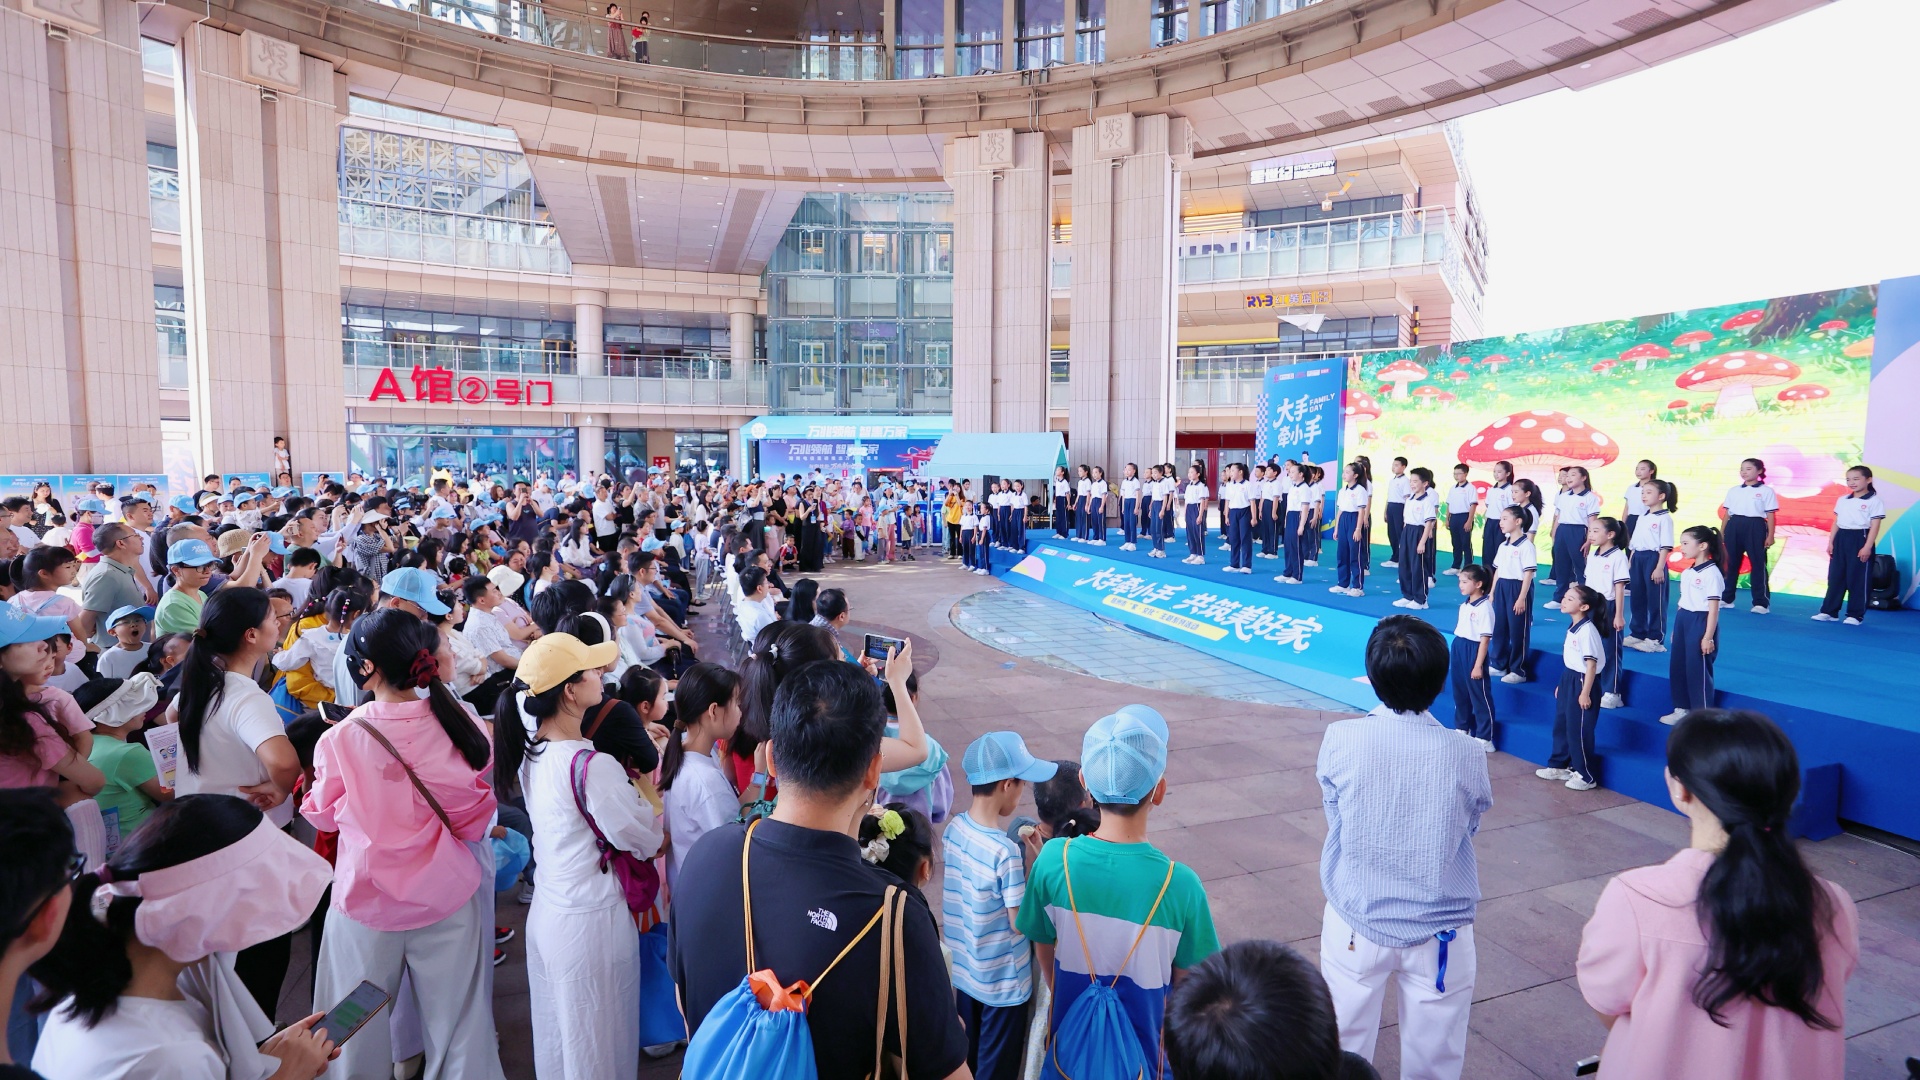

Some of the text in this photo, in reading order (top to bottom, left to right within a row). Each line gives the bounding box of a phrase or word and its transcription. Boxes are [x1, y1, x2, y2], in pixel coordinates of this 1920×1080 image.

[1275, 293, 1312, 306] 红黄蓝
[1309, 393, 1336, 406] FAMILY
[1272, 394, 1310, 430] 大手
[1309, 404, 1324, 413] DAY
[808, 425, 857, 438] 万兆领航
[1277, 414, 1323, 449] 牵小手
[788, 443, 880, 455] 万兆领航 智家
[1073, 567, 1324, 654] 大手牵小手 共筑美好家
[806, 909, 829, 923] NORTH
[818, 907, 831, 917] THE
[810, 917, 828, 928] FACE
